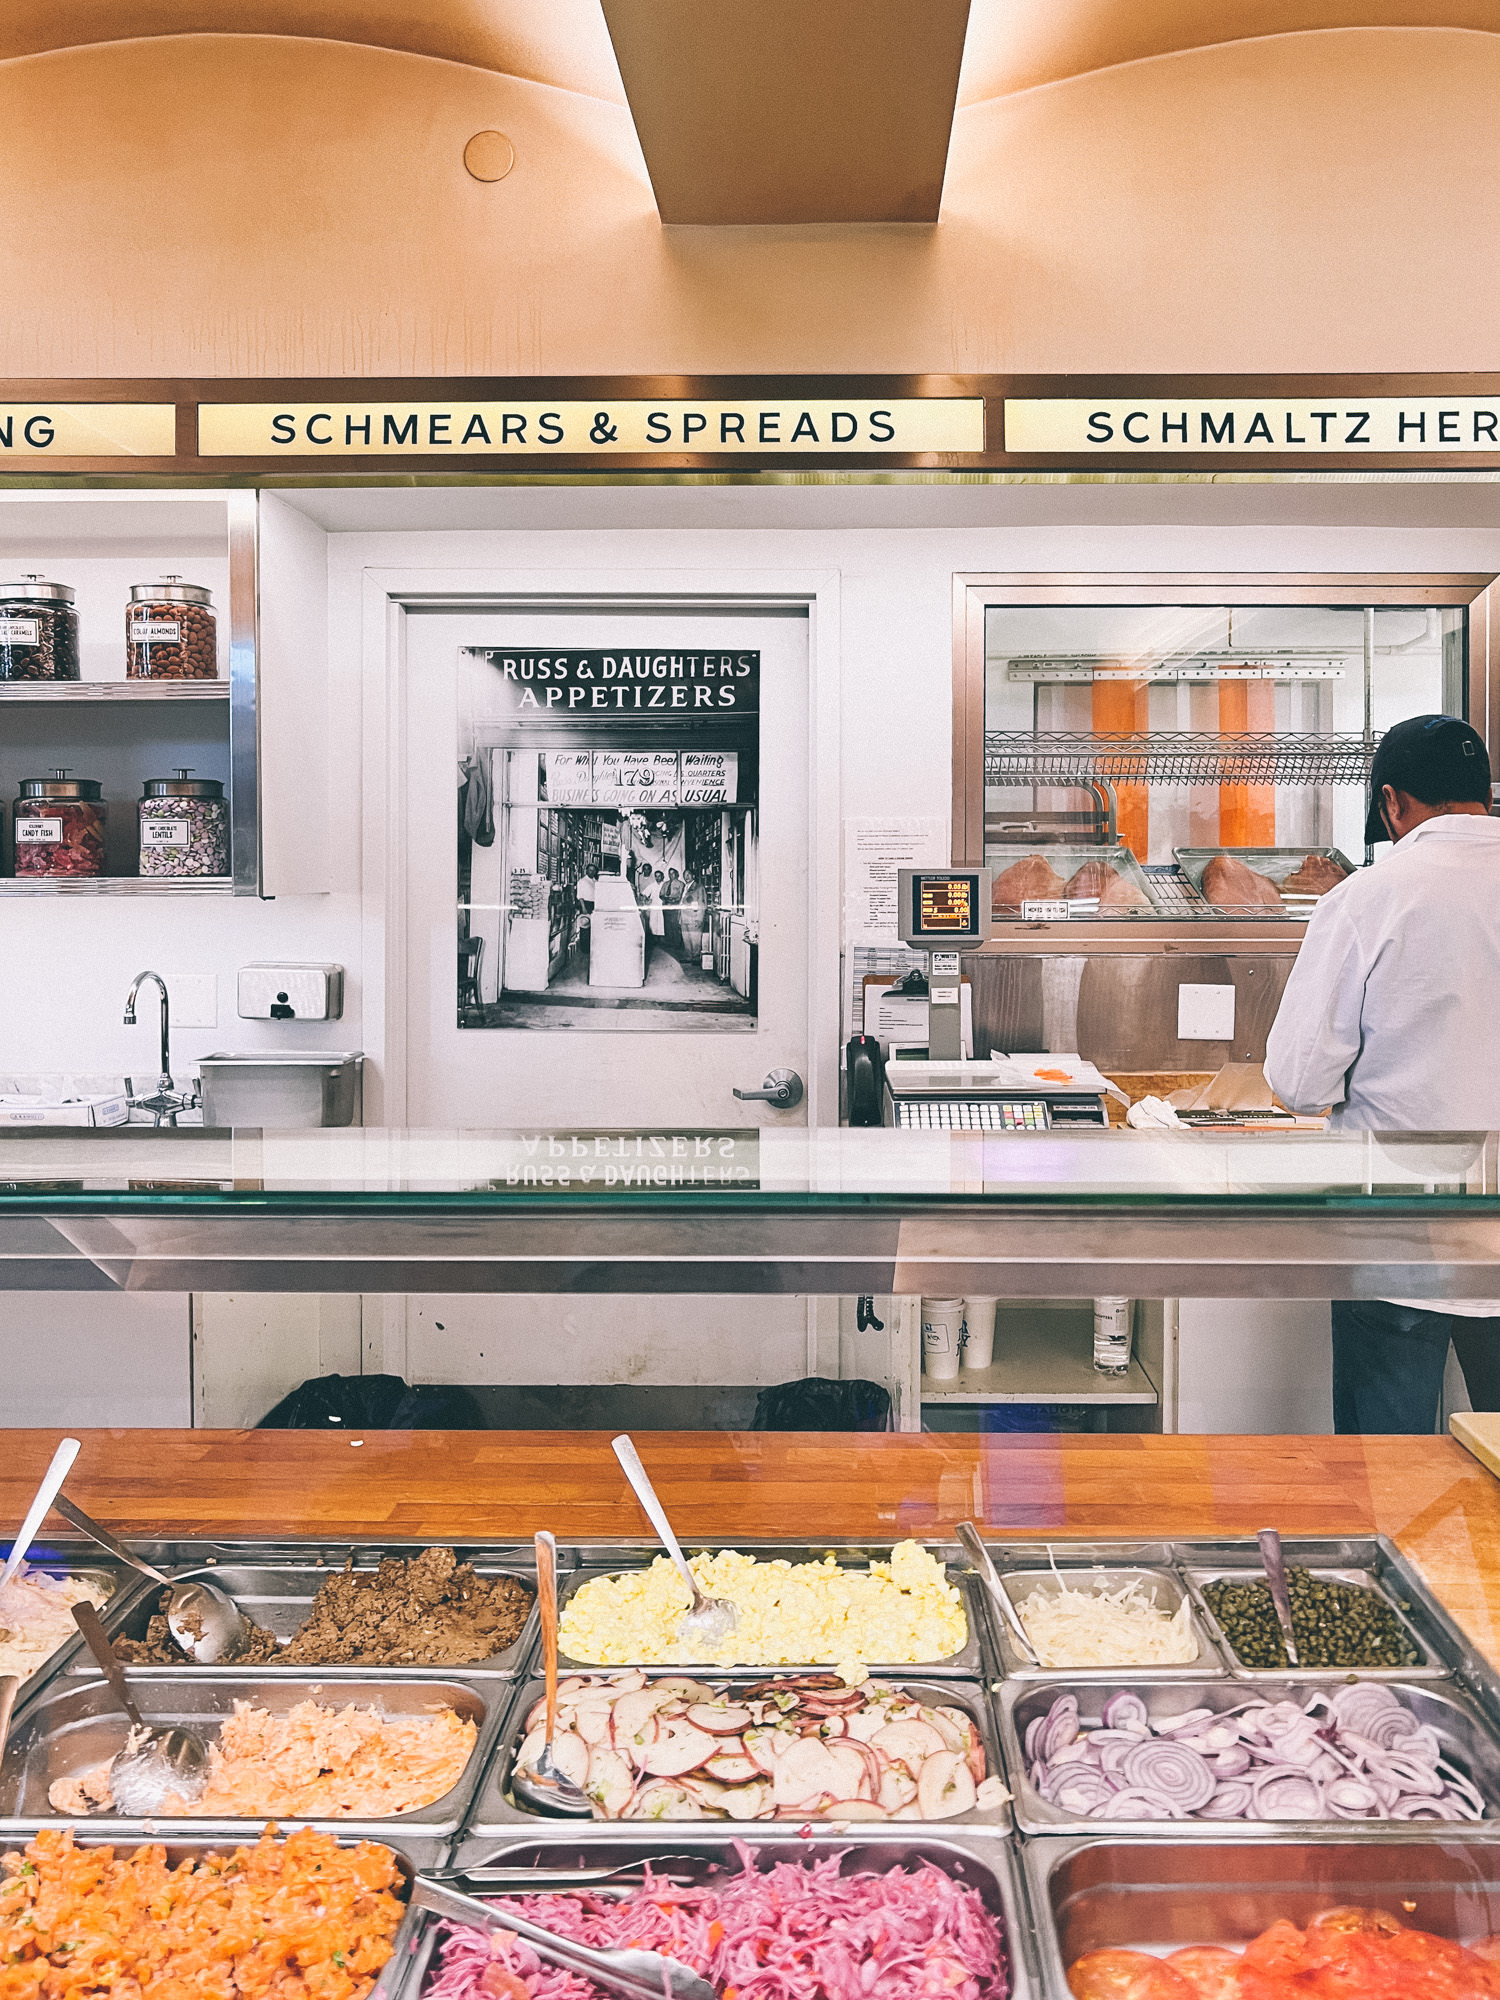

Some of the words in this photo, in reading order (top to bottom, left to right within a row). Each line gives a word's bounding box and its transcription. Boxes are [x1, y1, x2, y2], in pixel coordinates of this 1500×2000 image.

[270, 412, 565, 445] SCHMEARS
[588, 411, 619, 445] &
[645, 410, 896, 444] SPREADS
[1085, 411, 1371, 444] SCHMALTZ
[1398, 410, 1500, 444] HER
[503, 658, 568, 681] RUSS
[576, 659, 595, 680] &
[602, 655, 751, 679] DAUGHTERS
[518, 684, 737, 709] APPETIZERS
[554, 753, 573, 767] For
[575, 754, 599, 766] Wht
[603, 754, 620, 766] You
[623, 754, 649, 766] Have
[613, 768, 656, 788] 179
[687, 769, 727, 778] QUARTERS
[552, 788, 599, 803] BUSINES
[603, 788, 636, 803] GOING
[639, 789, 657, 803] ON
[658, 789, 678, 803] AS
[684, 789, 728, 804] USUAL
[22, 829, 39, 837] CANDY
[40, 829, 54, 837] FISH
[152, 831, 173, 839] LENTILS
